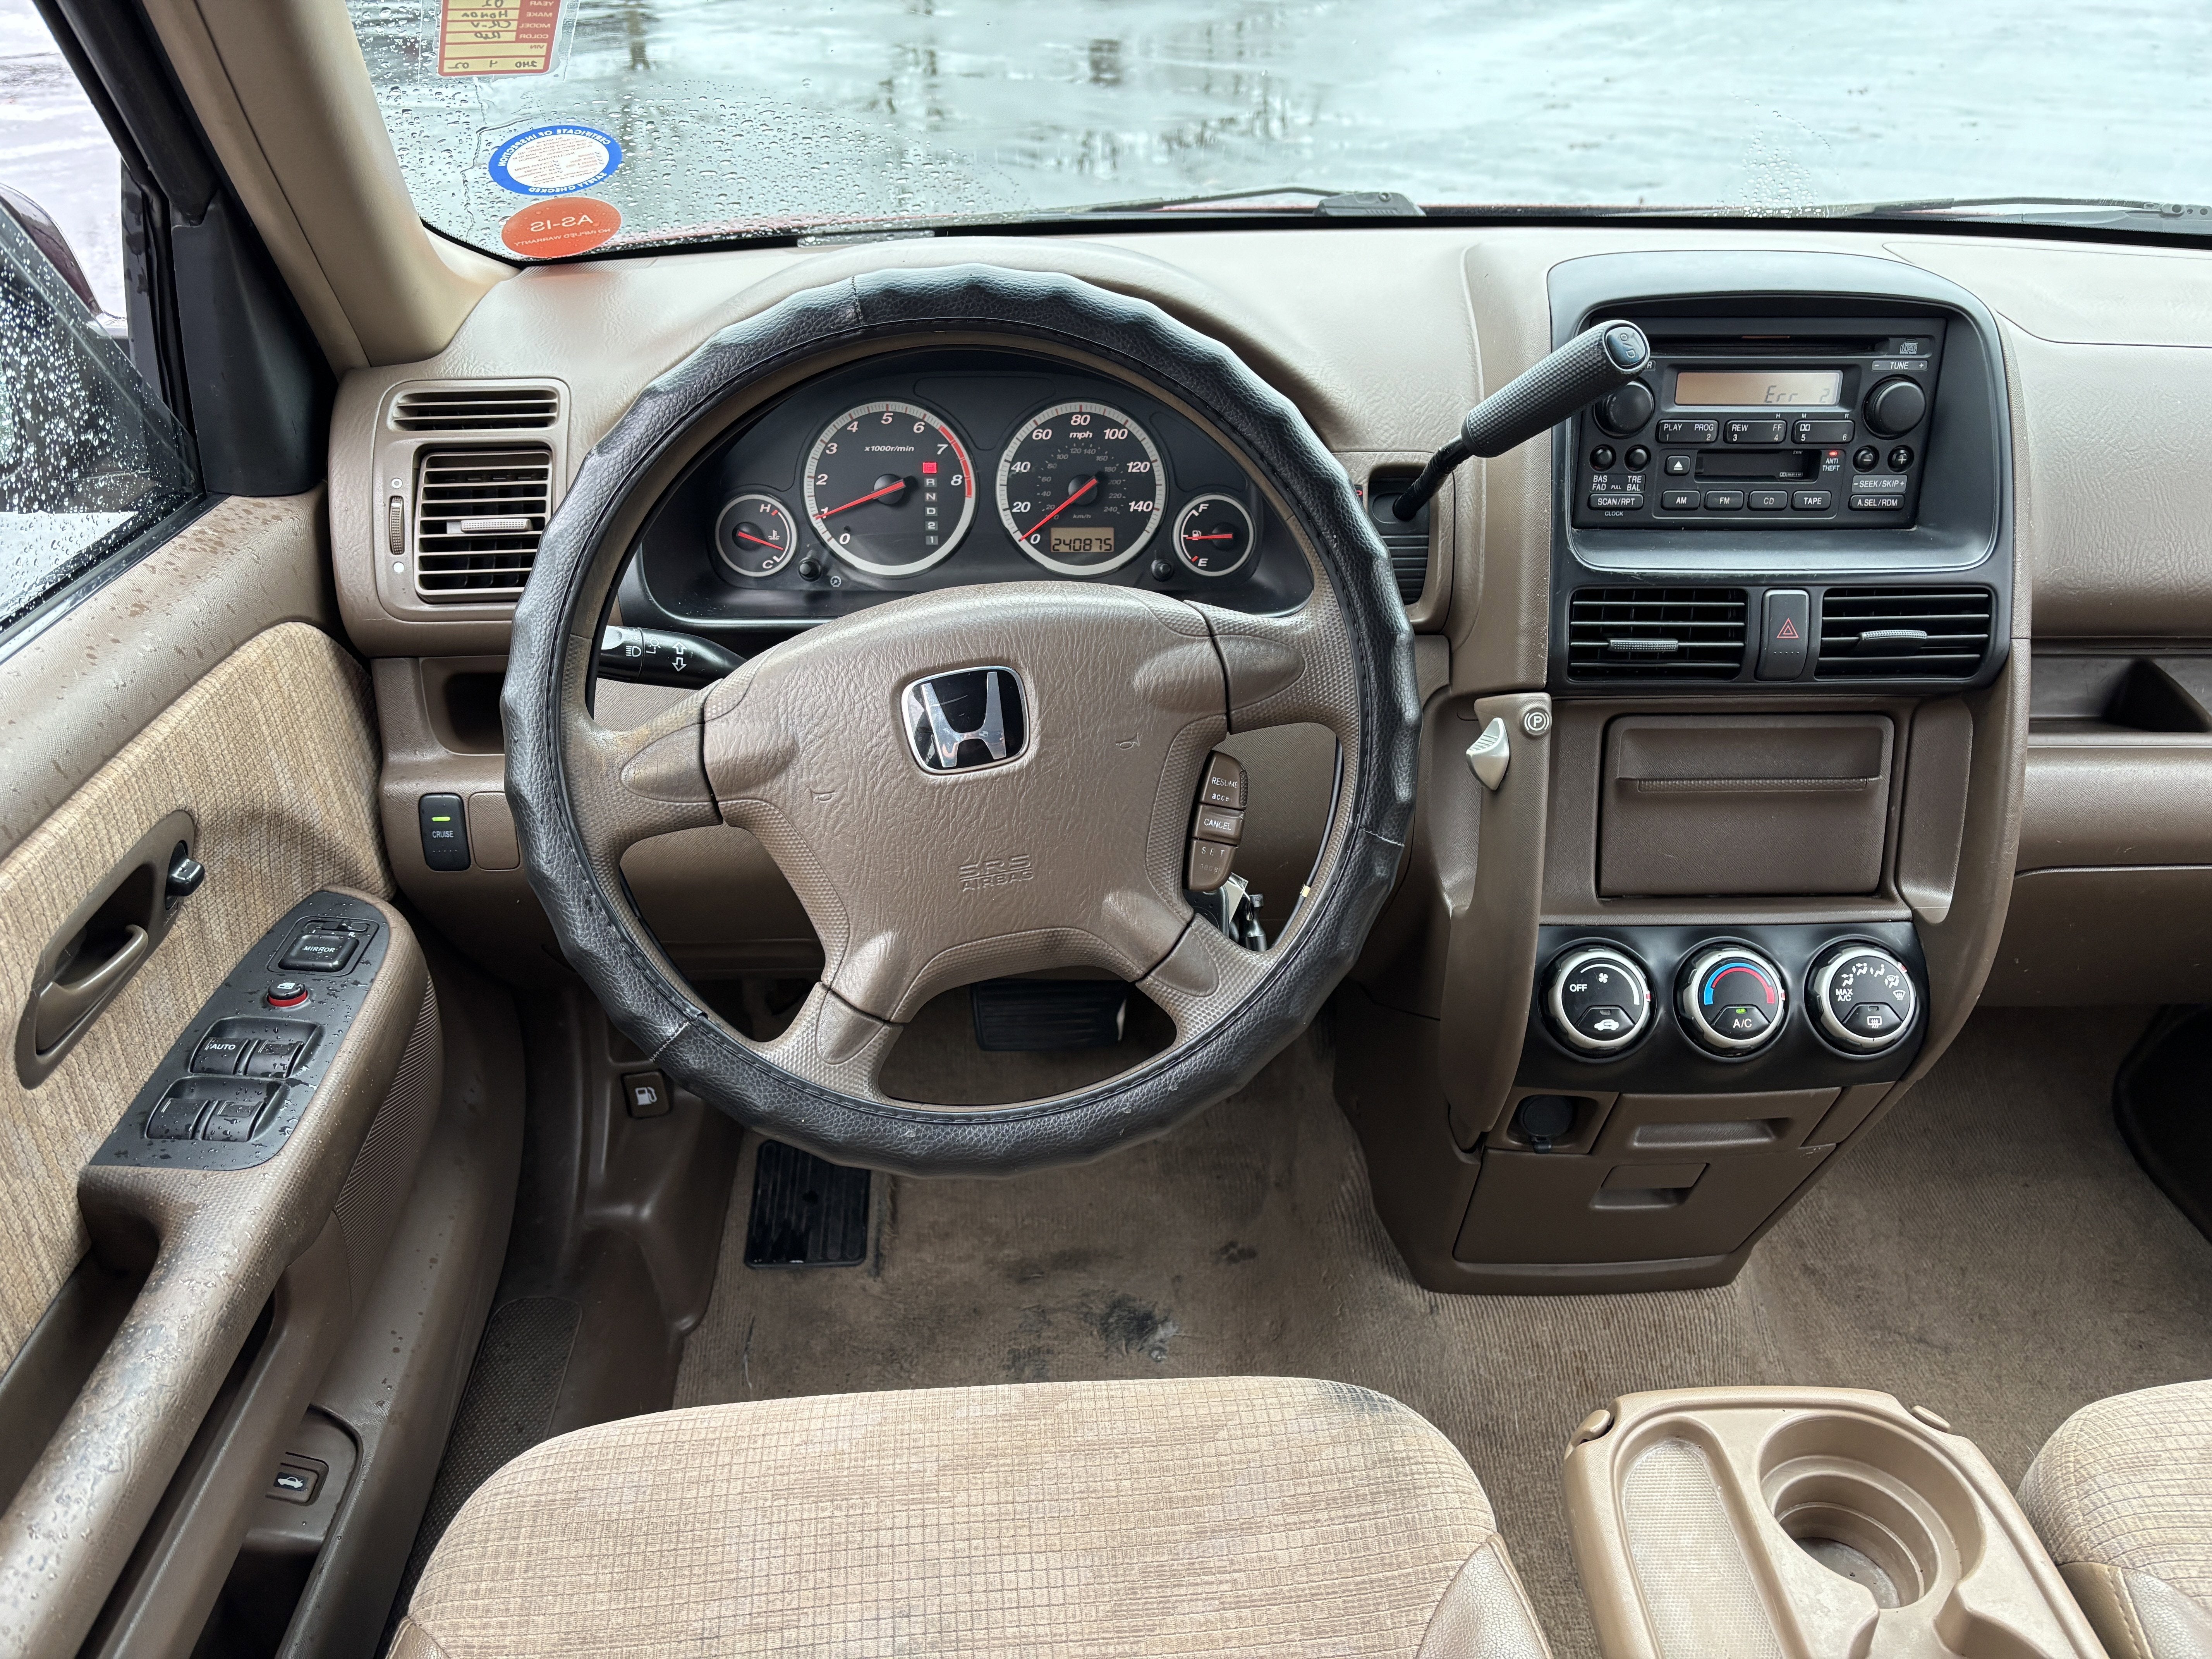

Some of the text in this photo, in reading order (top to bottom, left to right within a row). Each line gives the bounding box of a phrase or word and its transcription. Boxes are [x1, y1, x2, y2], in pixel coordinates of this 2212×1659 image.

[1764, 385, 1798, 404] Err
[881, 413, 893, 424] 5
[1070, 414, 1091, 425] 80
[847, 421, 858, 433] 4
[913, 422, 925, 433] 6
[1032, 429, 1052, 440] 60
[1069, 431, 1093, 440] mph
[1103, 428, 1128, 439] 100
[826, 443, 838, 454] 3
[864, 445, 915, 453] x1000r/min
[937, 444, 948, 455] 7
[1011, 461, 1031, 472] 40
[1127, 462, 1151, 472] 120
[816, 474, 828, 485] 2
[950, 475, 963, 486] 8
[759, 504, 771, 513] H
[1012, 501, 1031, 512] 20
[1128, 501, 1153, 512] 140
[1198, 504, 1209, 513] F
[839, 533, 850, 544] 0
[1030, 534, 1041, 544] 0
[1052, 538, 1112, 551] 240875
[762, 560, 773, 569] C
[1197, 558, 1208, 567] E
[1211, 776, 1238, 789] RESUME
[1212, 793, 1232, 802] acce
[1204, 818, 1231, 831] CANCEL
[958, 854, 1031, 880] SRS
[962, 870, 1034, 892] AIRBAG
[1569, 984, 1588, 992] OFF
[1733, 1018, 1752, 1029] A/C
